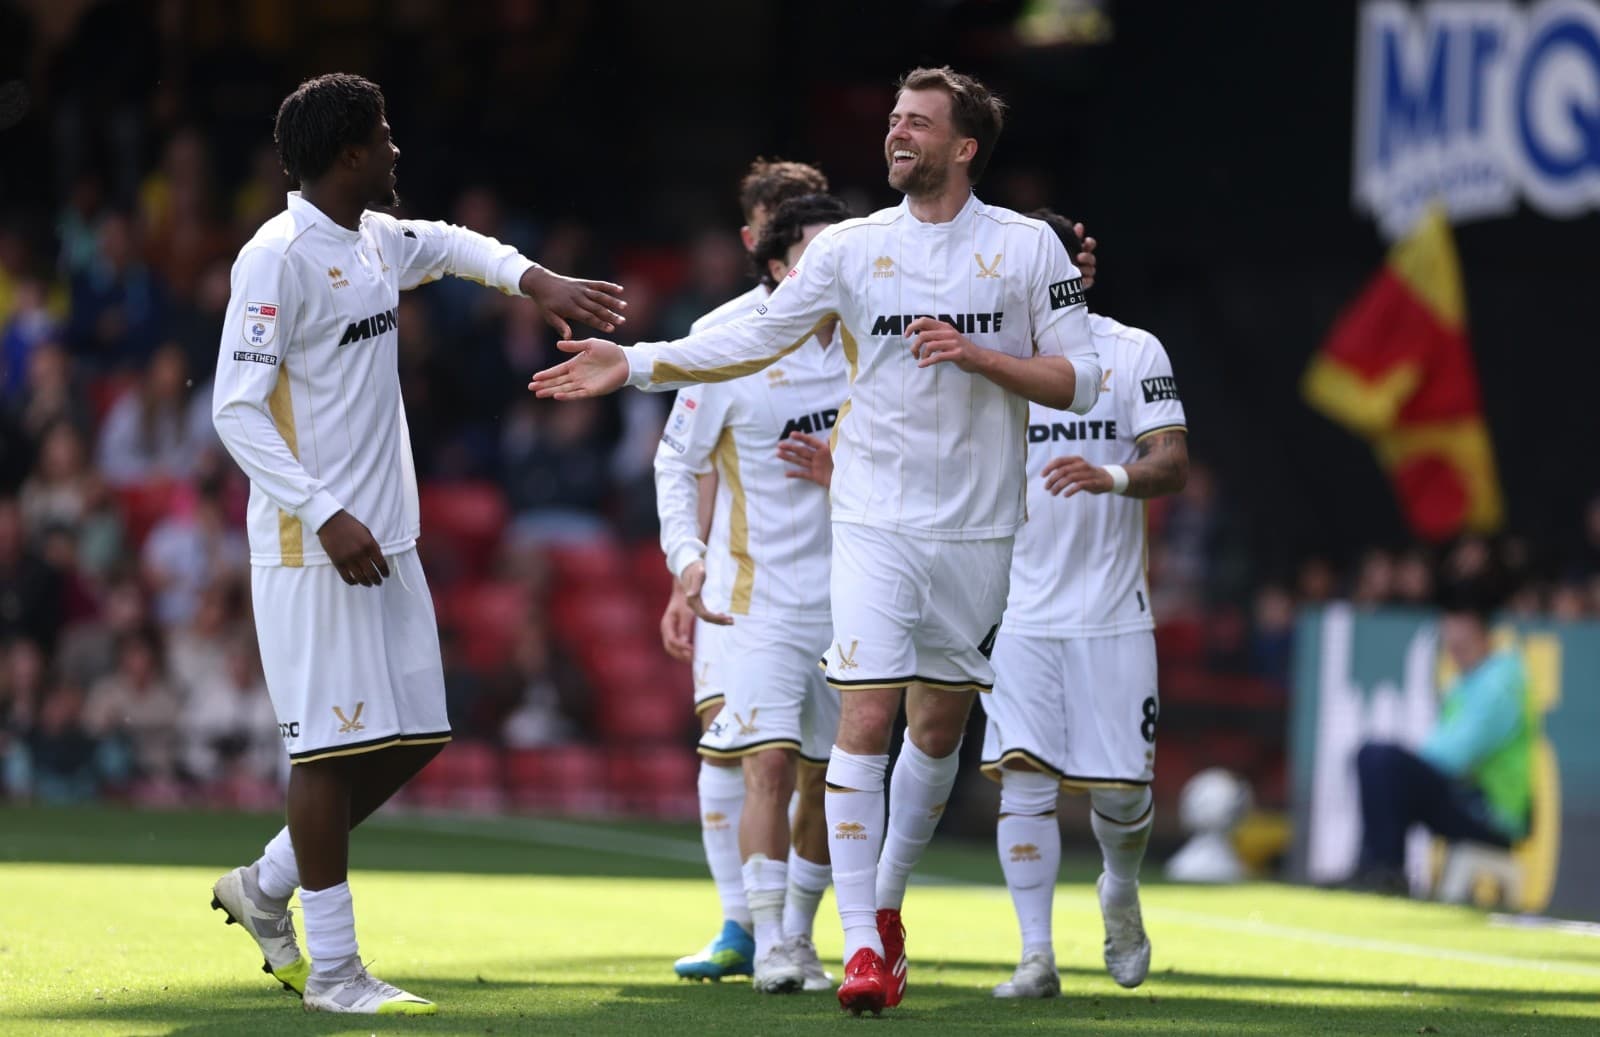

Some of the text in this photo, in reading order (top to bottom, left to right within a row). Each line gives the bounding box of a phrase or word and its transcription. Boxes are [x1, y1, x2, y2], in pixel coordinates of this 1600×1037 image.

[338, 306, 398, 347] MIDN
[235, 352, 276, 365] TOGETHER
[1141, 697, 1157, 743] 8
